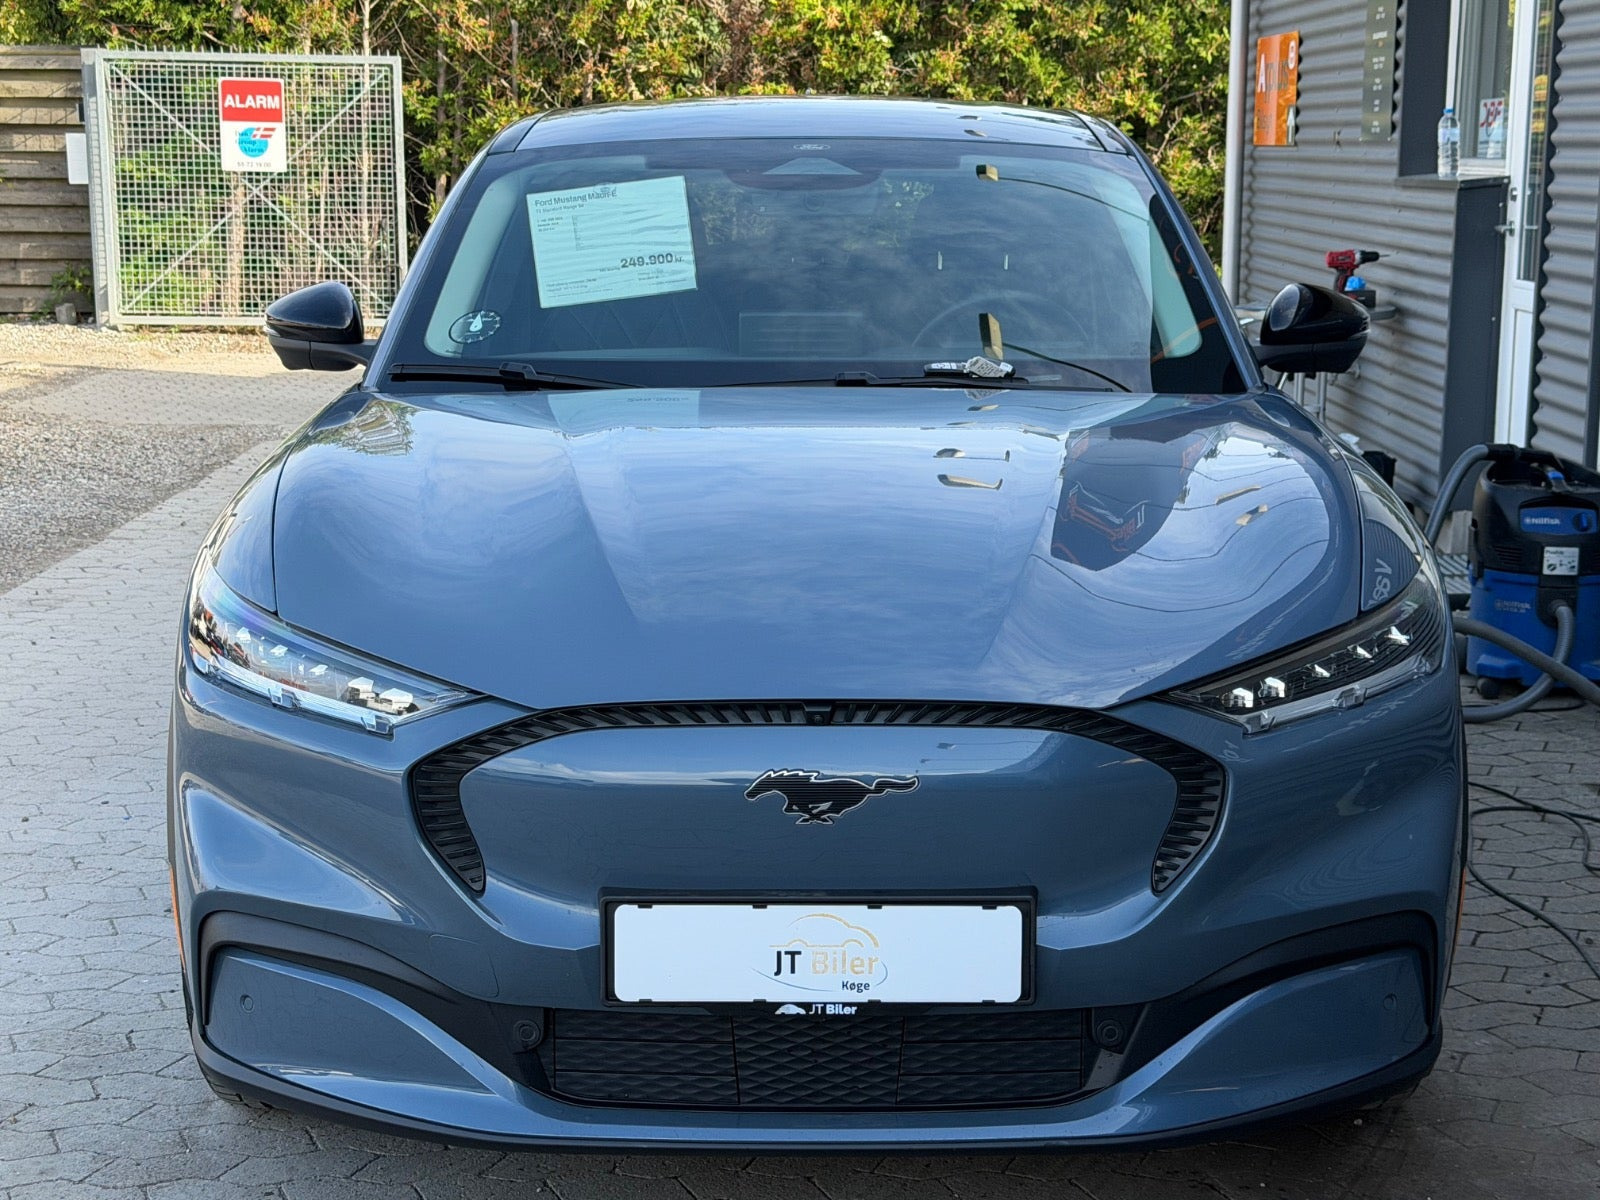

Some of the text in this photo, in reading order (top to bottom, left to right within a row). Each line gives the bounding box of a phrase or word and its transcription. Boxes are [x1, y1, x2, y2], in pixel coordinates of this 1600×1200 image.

[224, 94, 280, 109] ALARM
[535, 197, 553, 207] Ford
[553, 191, 587, 205] Mustang
[620, 252, 673, 268] 249.900
[774, 950, 879, 976] JT Biler
[841, 980, 871, 993] Køge
[809, 1003, 858, 1015] JT Biler
